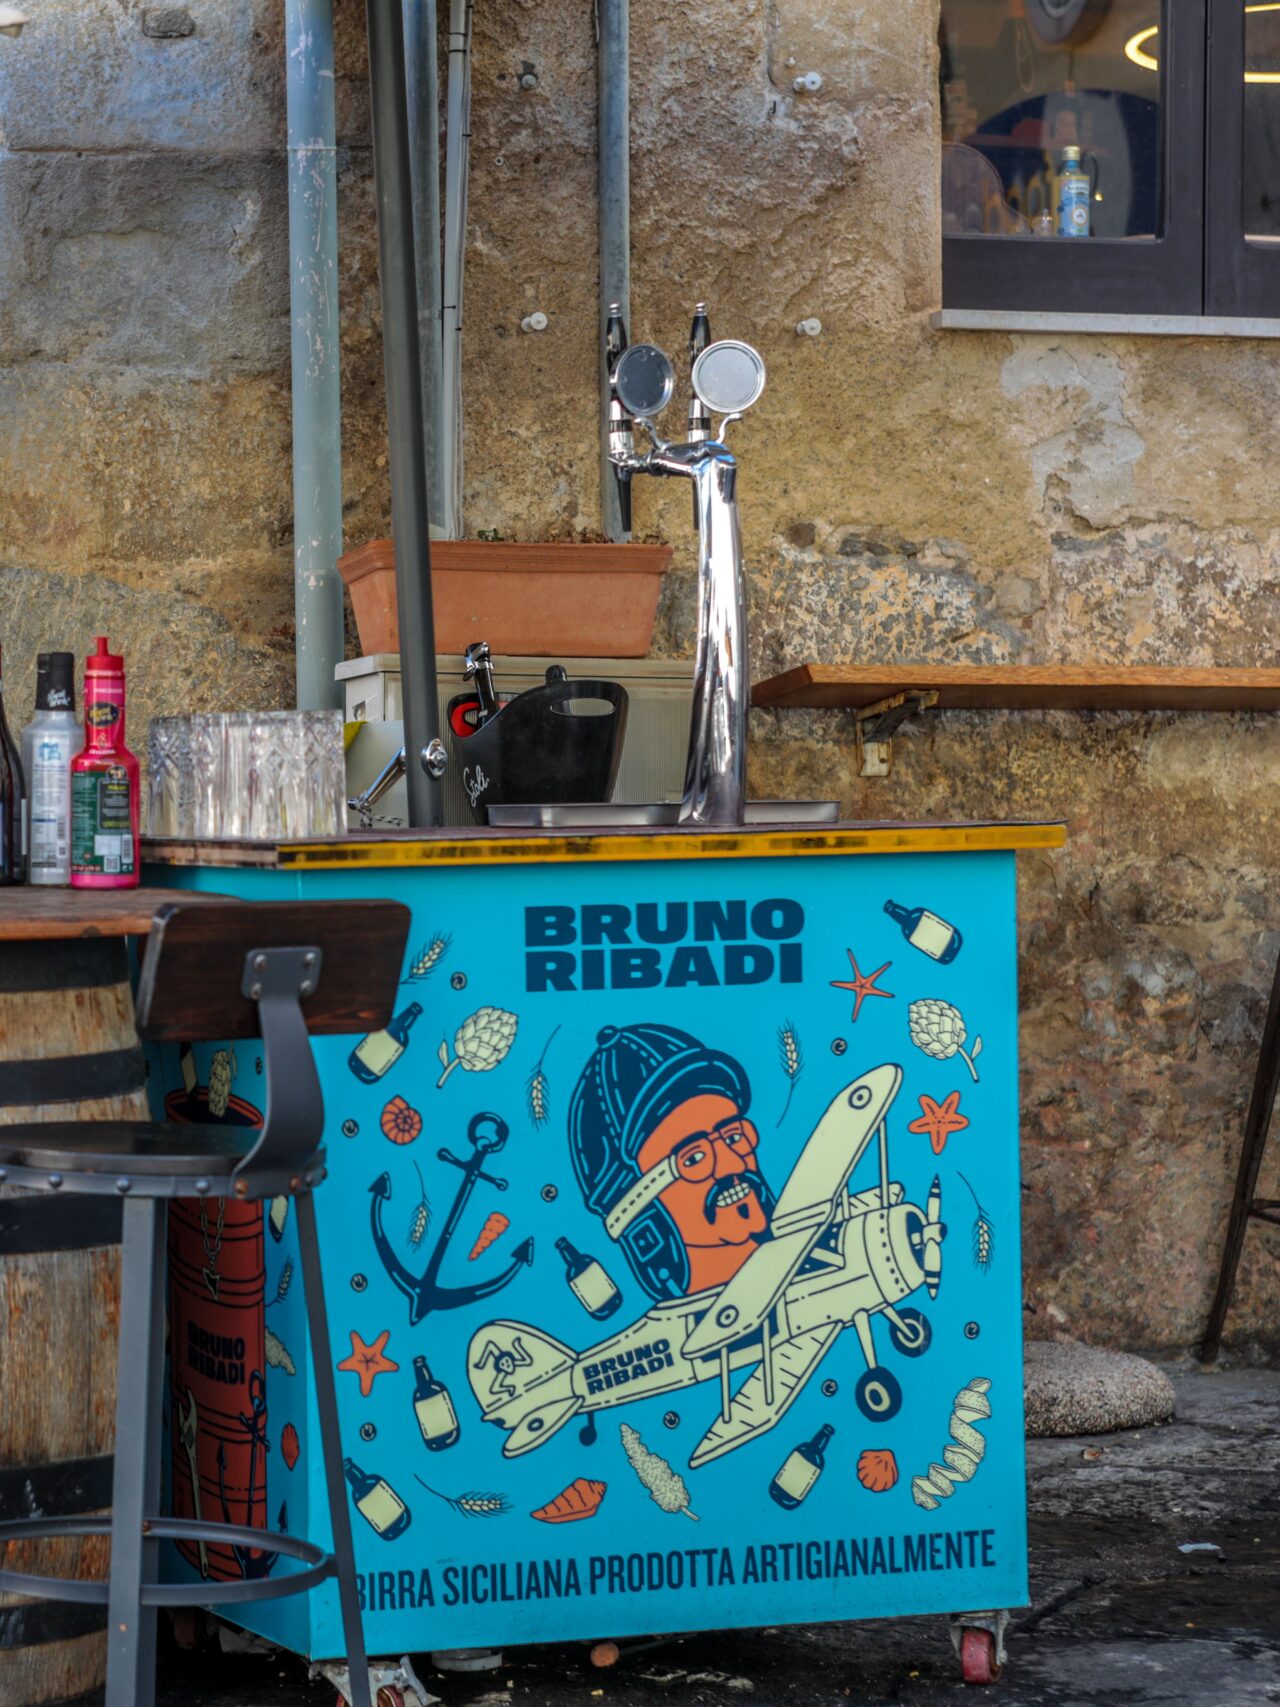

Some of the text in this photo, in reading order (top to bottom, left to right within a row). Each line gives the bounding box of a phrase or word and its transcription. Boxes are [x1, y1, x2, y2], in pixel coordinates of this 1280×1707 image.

[524, 898, 806, 947] BRUNO
[525, 942, 804, 993] RIBADI
[187, 1320, 245, 1361] BRUNO
[582, 1338, 671, 1380] BRUNO
[187, 1344, 245, 1386] RIBADI
[587, 1352, 674, 1395] RIBADI
[442, 1558, 582, 1607] SICILIANA
[589, 1548, 736, 1596] PRODOTTA
[742, 1529, 997, 1584] ARTIGIANALMENTE
